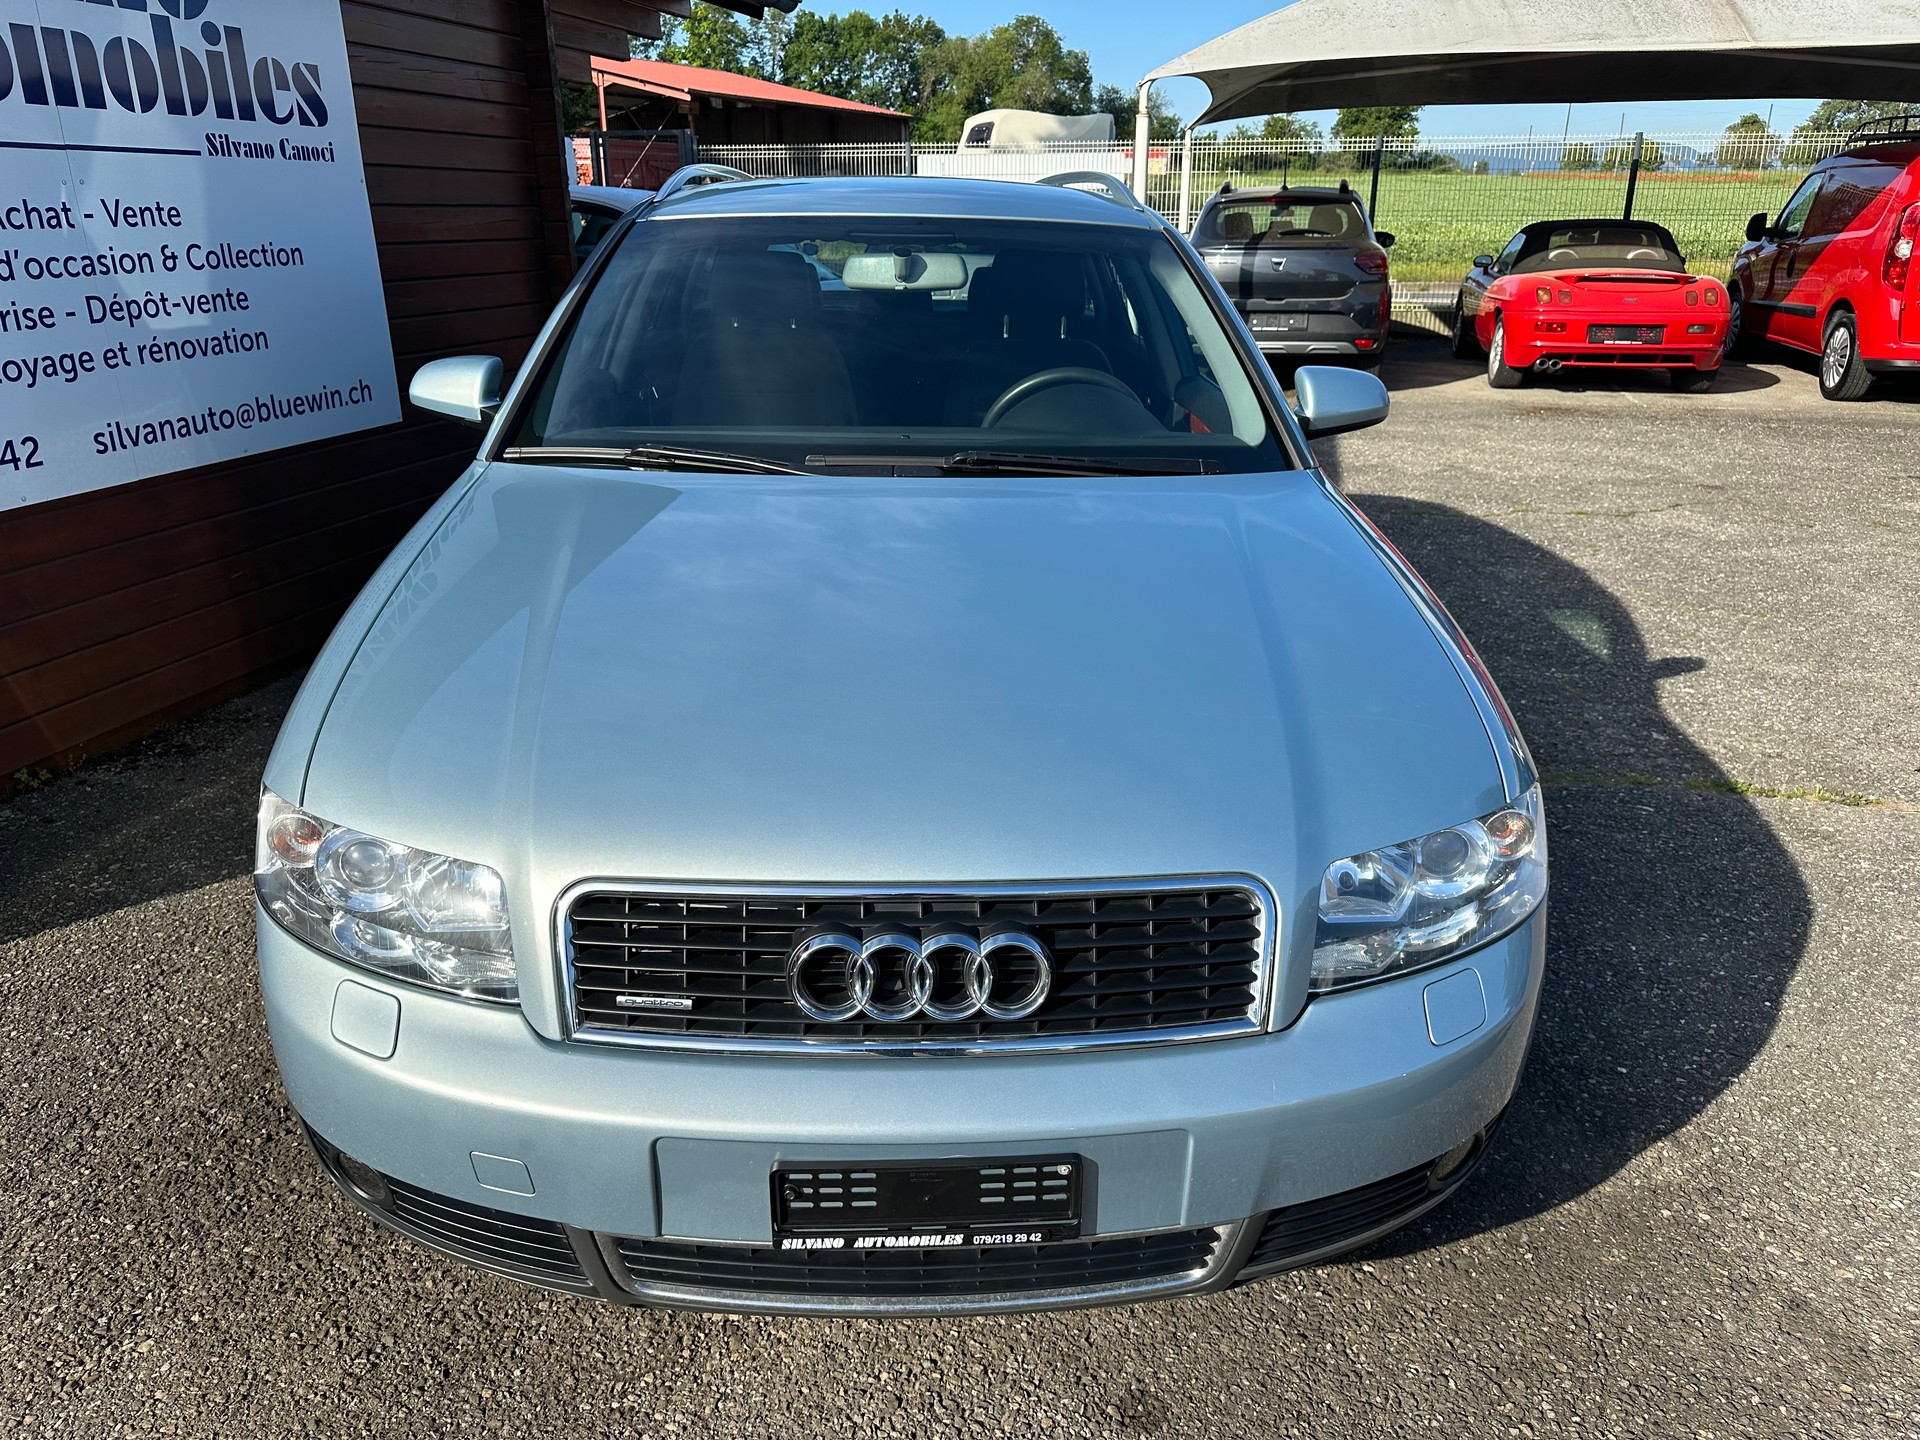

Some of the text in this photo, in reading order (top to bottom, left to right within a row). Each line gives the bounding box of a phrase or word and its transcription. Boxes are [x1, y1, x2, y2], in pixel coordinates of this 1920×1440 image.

[0, 12, 329, 127] mobiles
[204, 132, 335, 163] Silvano Canoci
[0, 198, 76, 230] chat
[100, 198, 182, 229] Vente
[0, 241, 304, 282] d'occasion & Collection
[84, 288, 250, 328] Dépôt-vente
[0, 327, 270, 389] oyage et rénovation
[0, 379, 373, 471] 42 silvanauto@bluewin.ch
[624, 998, 684, 1007] quattro
[781, 1232, 1042, 1250] SILVANO AUTOMOBILES 079/219 29 42
